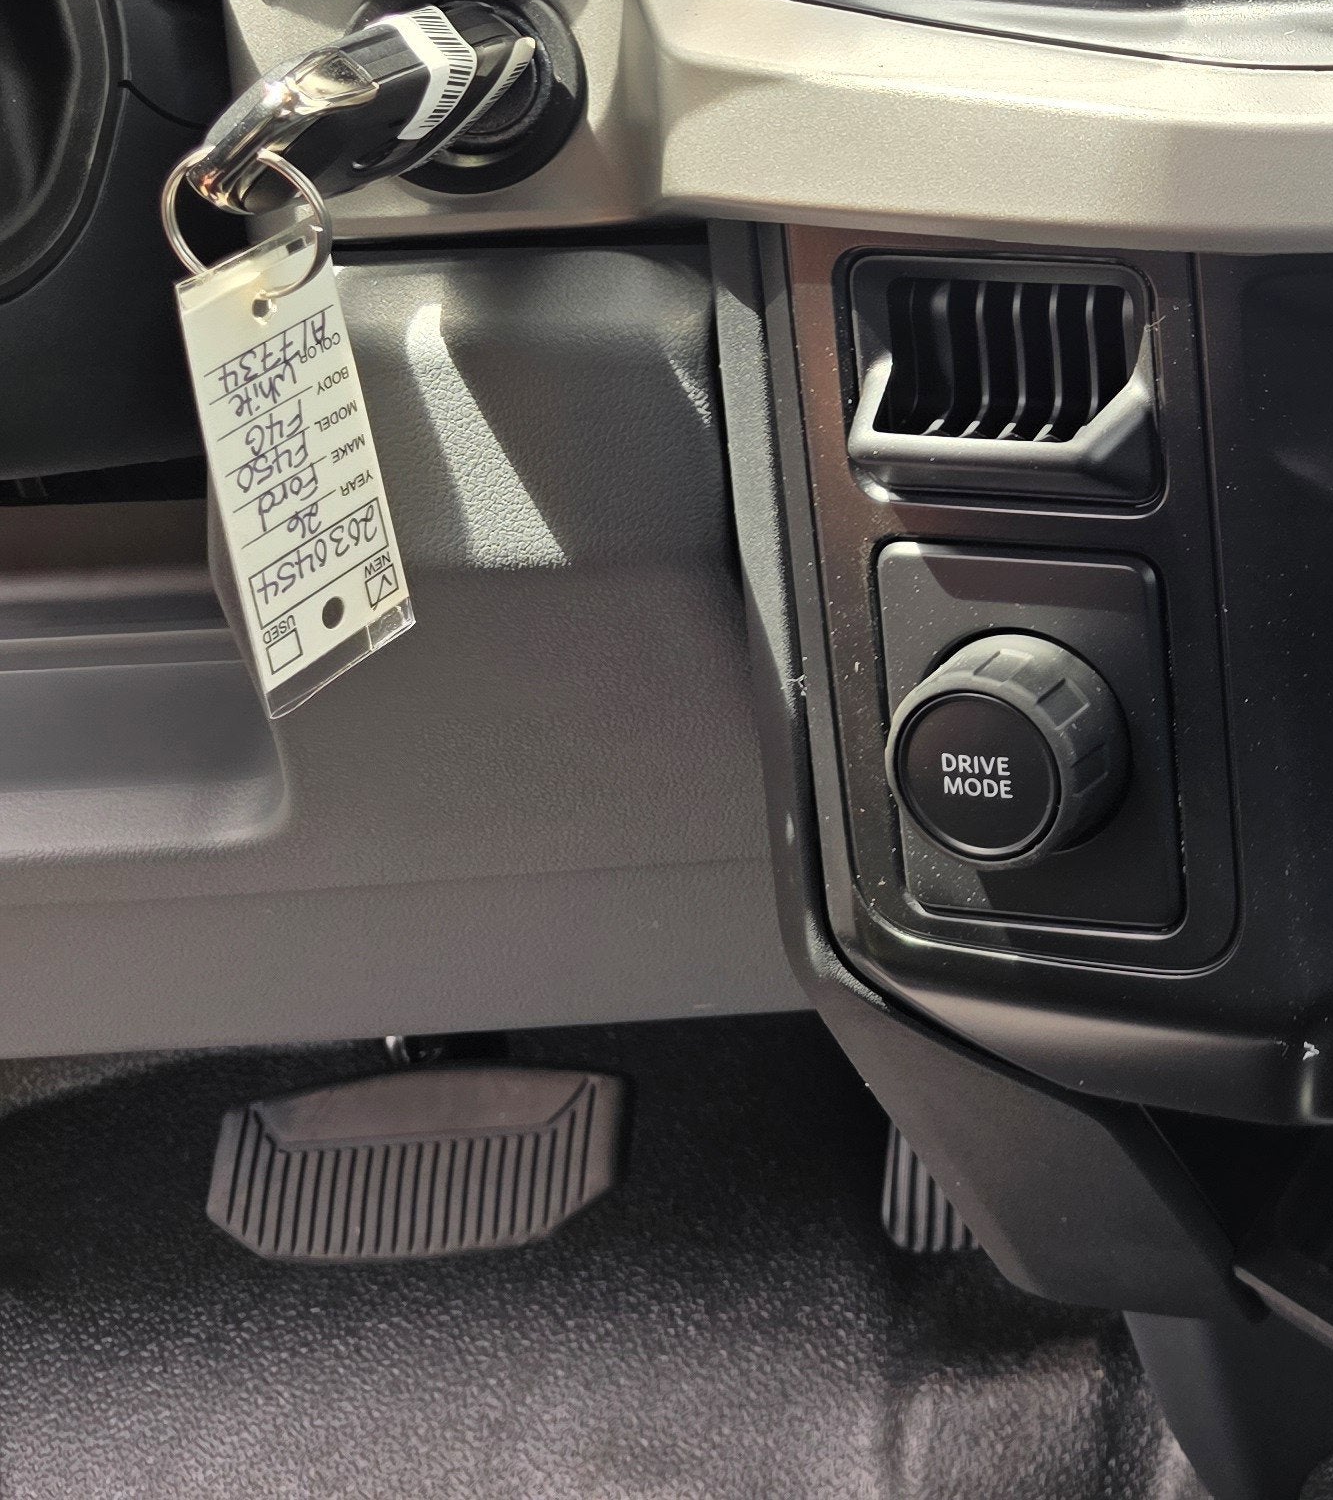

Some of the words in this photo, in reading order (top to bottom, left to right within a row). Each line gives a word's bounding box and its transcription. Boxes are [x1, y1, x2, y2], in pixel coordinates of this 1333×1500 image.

[299, 332, 341, 364] COLOR
[317, 366, 350, 395] BODY
[314, 400, 358, 432] MODEL
[236, 430, 309, 493] F450
[331, 434, 366, 464] MAKE
[258, 462, 319, 532] Ford
[340, 469, 373, 497] YEAR
[287, 501, 322, 539] 26
[364, 551, 391, 578] NEW
[262, 614, 296, 645] USED
[940, 752, 1011, 777] DRIVE
[943, 776, 1014, 799] MODE
